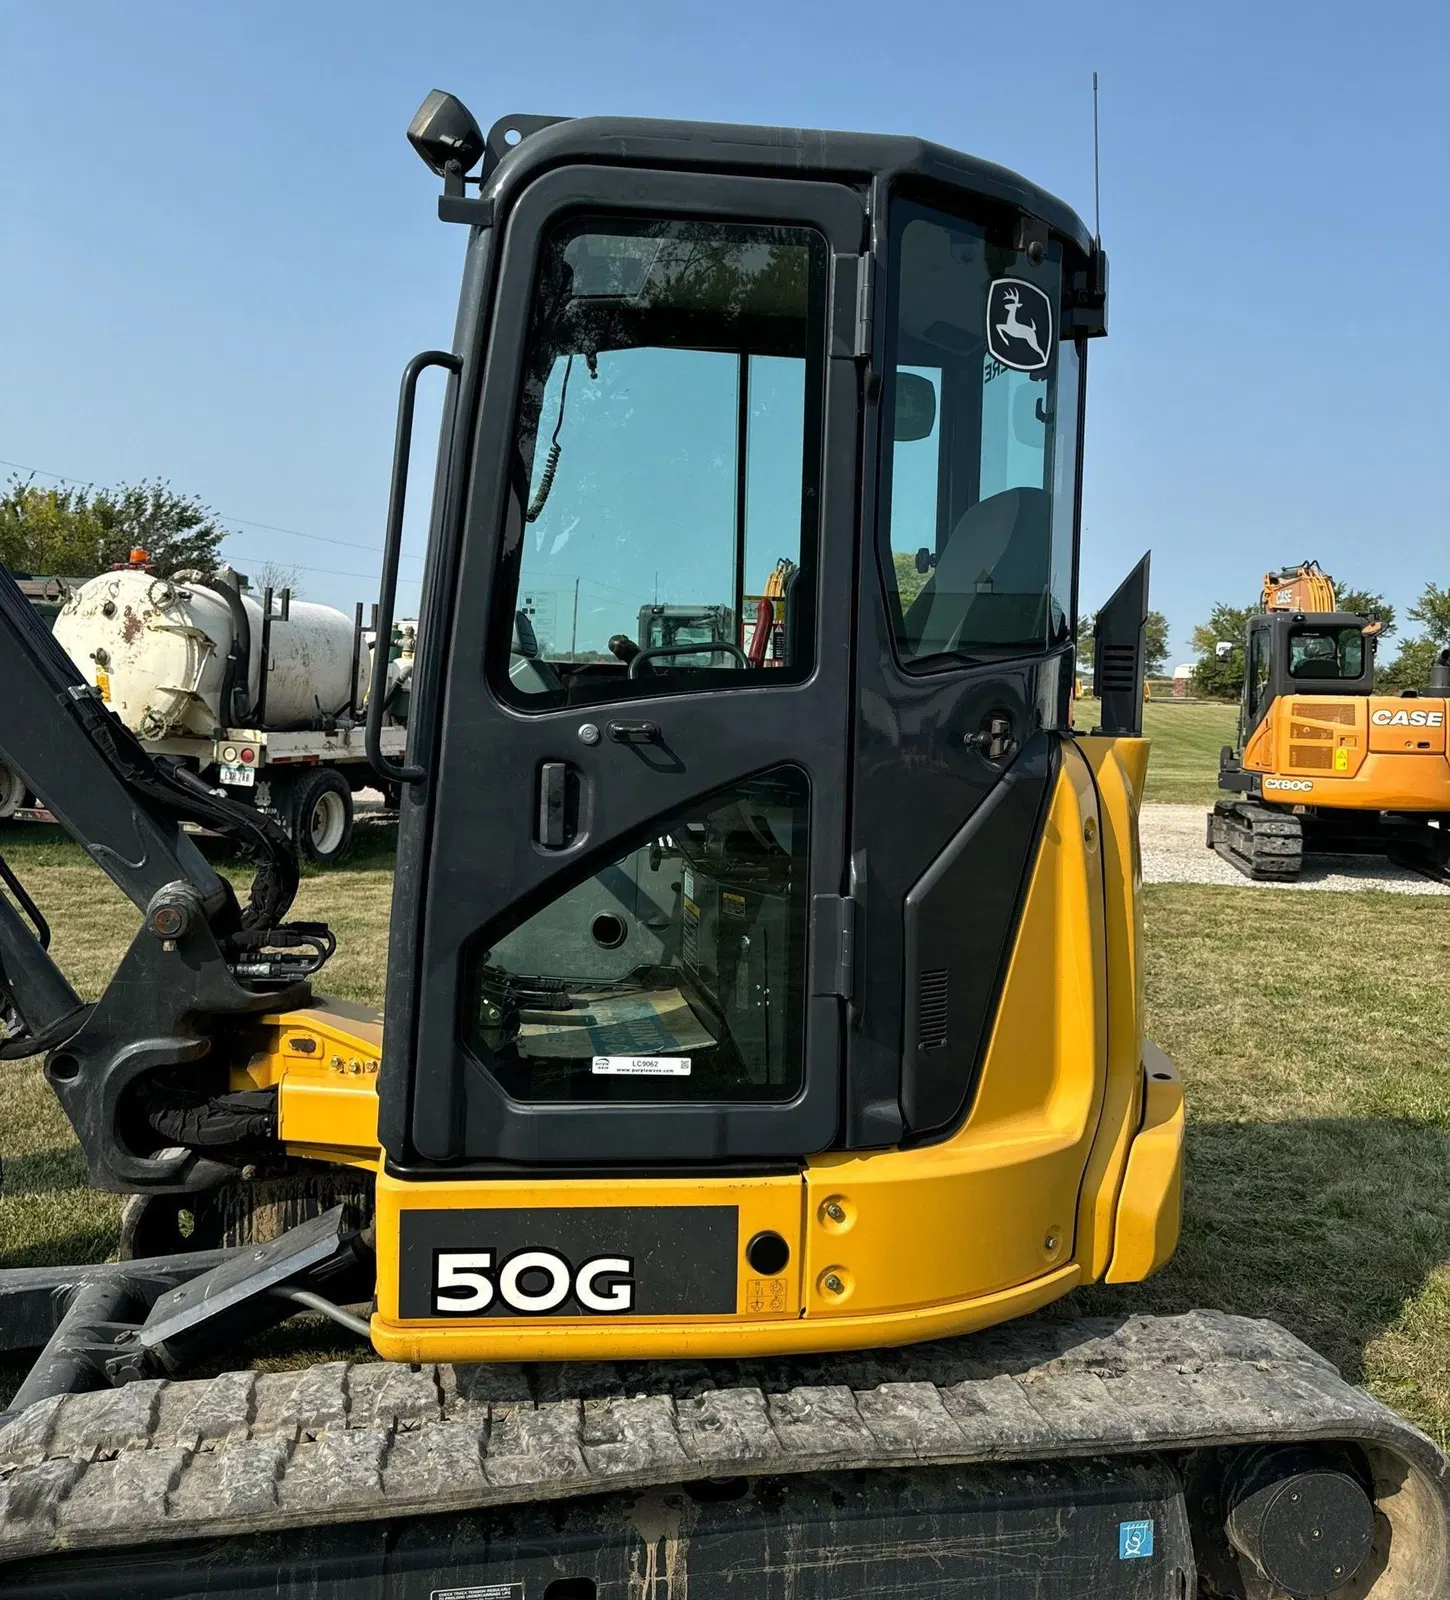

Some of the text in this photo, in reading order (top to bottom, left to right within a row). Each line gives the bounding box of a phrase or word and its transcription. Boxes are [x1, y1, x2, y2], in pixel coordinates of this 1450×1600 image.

[1371, 709, 1444, 727] CASE
[1264, 778, 1313, 792] CX80C
[434, 1249, 633, 1314] 50G
